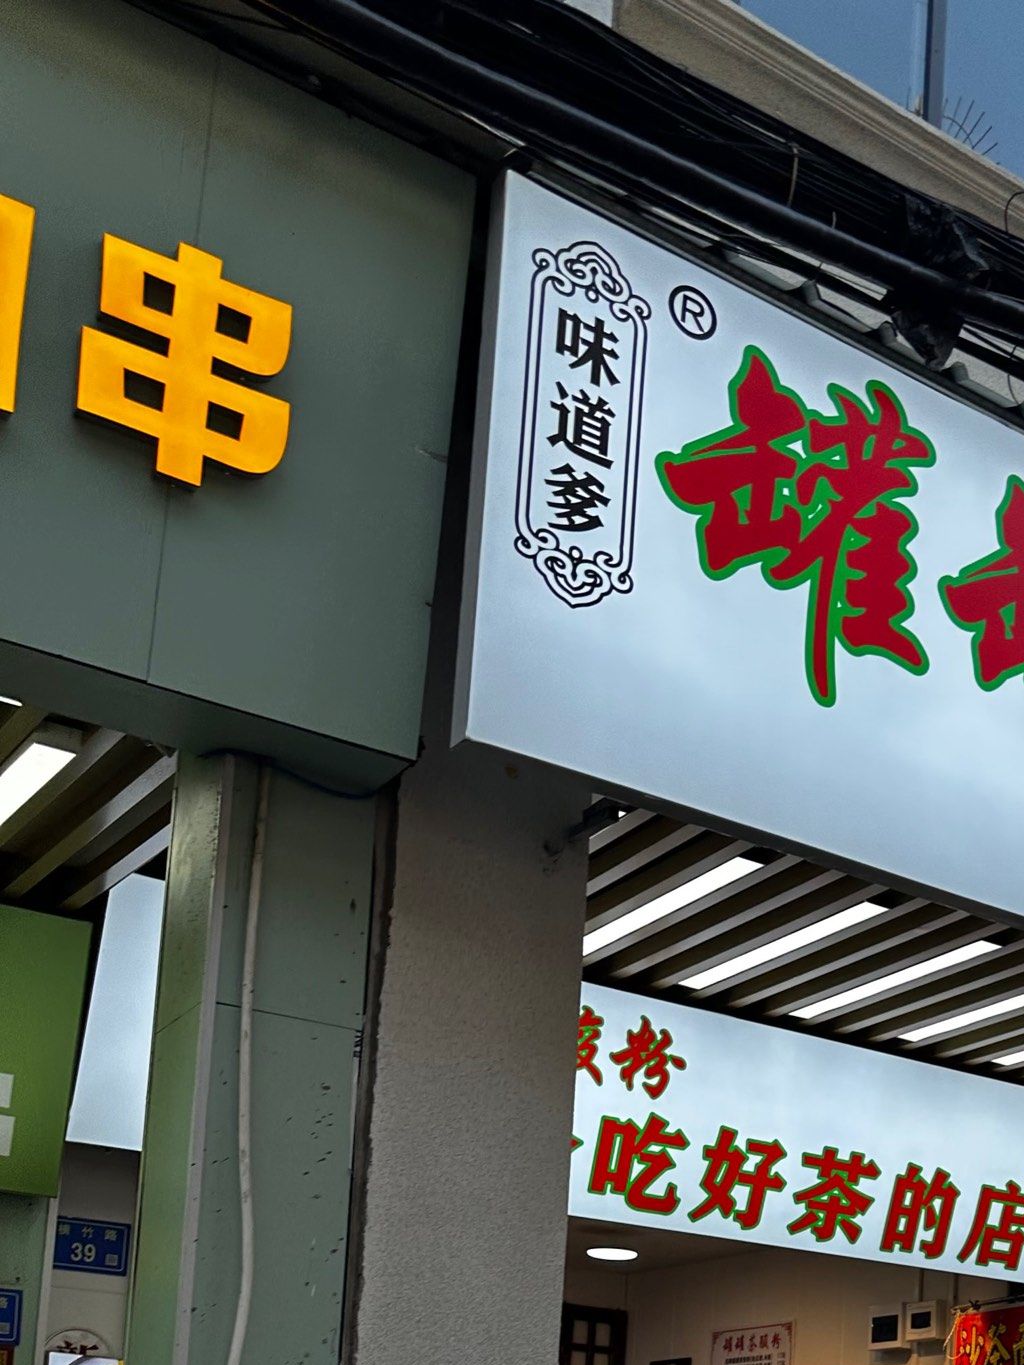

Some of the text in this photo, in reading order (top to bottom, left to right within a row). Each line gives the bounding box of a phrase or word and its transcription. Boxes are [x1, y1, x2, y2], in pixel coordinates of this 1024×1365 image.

[0, 193, 292, 487] 串
[544, 307, 620, 532] 味道爹
